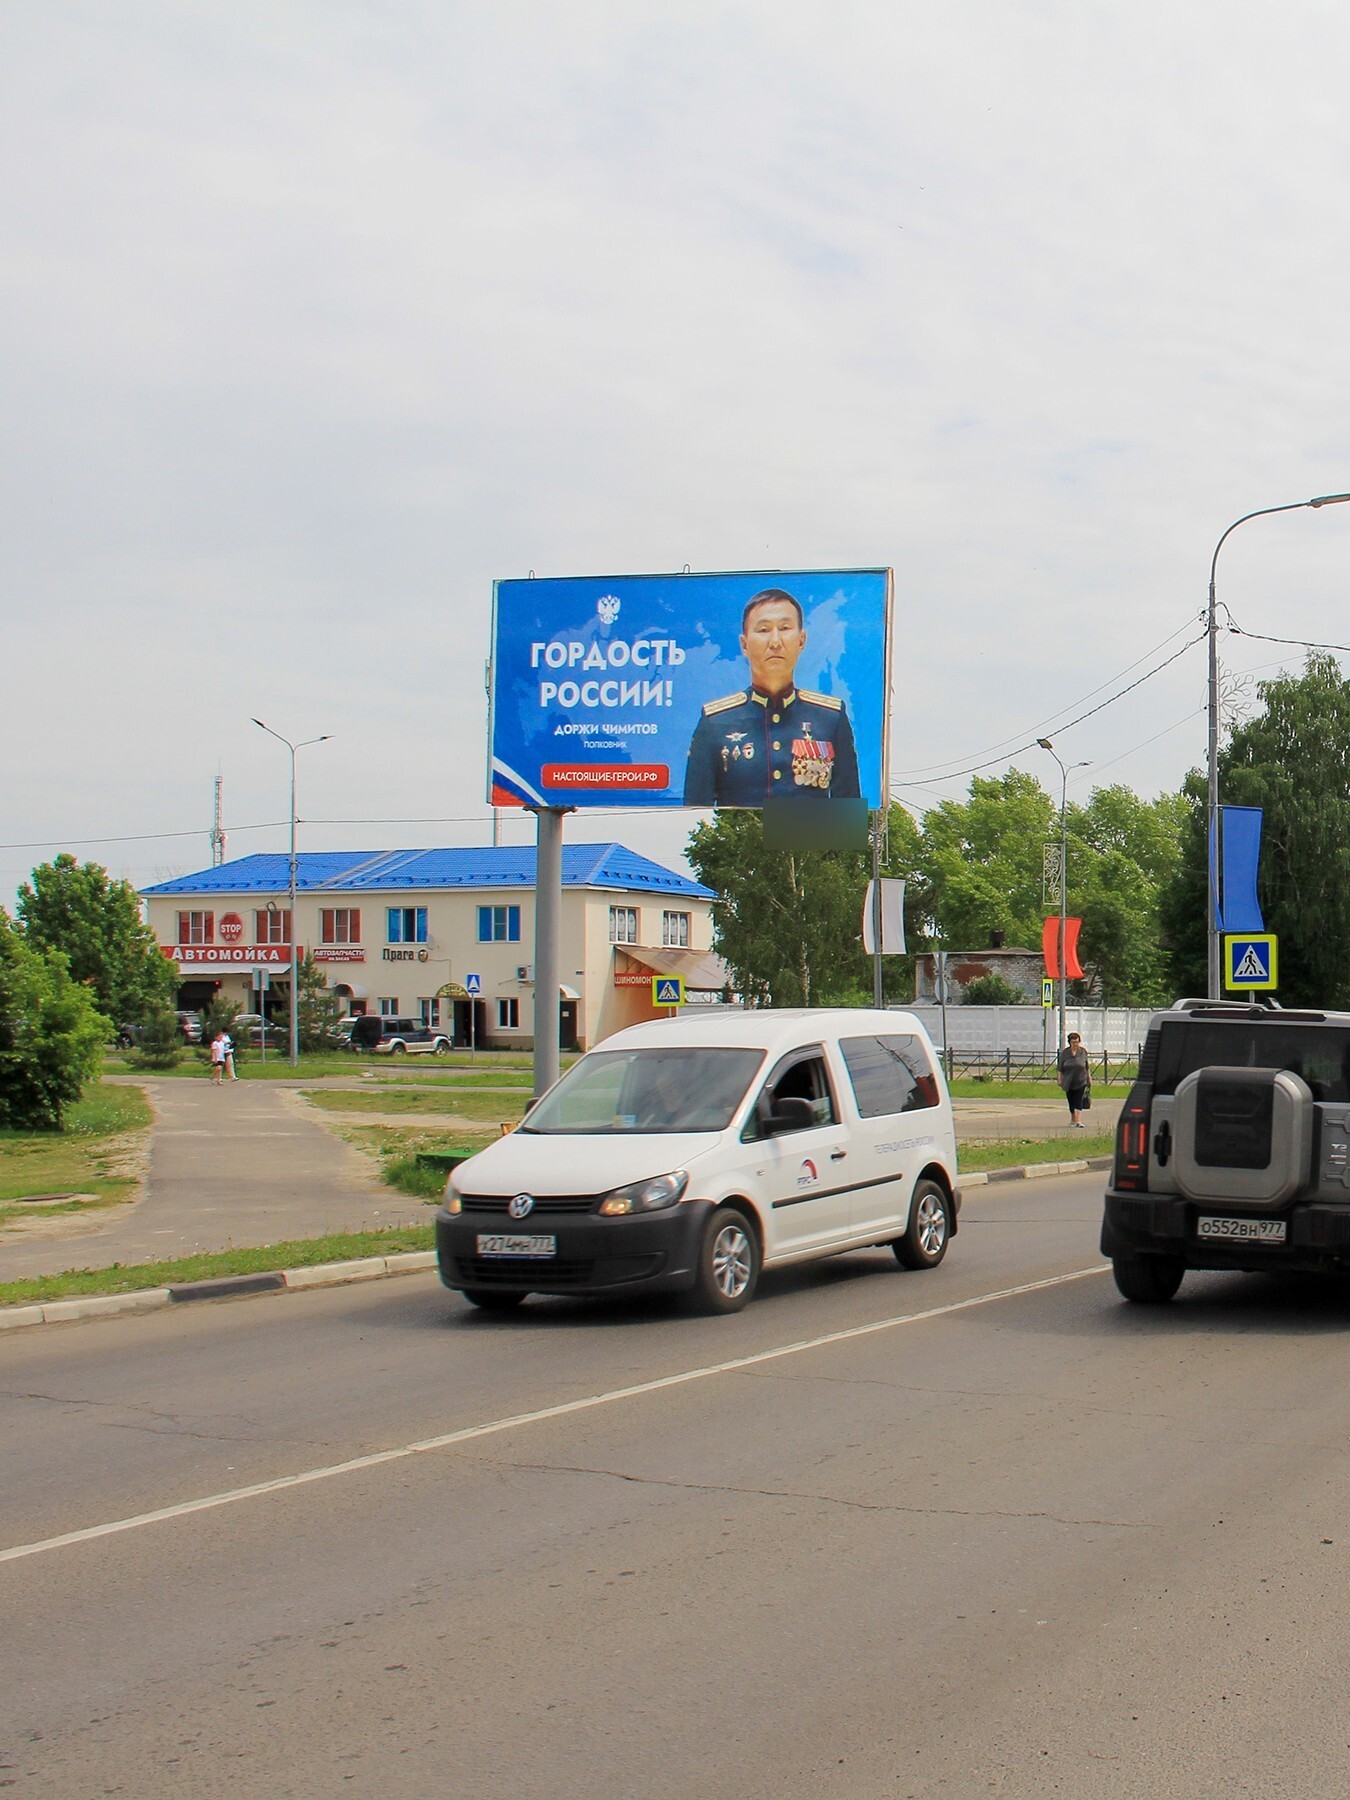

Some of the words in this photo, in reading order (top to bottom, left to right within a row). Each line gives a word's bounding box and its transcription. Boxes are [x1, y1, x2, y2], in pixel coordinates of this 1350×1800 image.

[530, 639, 687, 671] ГОРДОСТЬ
[540, 680, 674, 708] РОССИИ!
[553, 724, 599, 736] ДОРЖИ
[601, 723, 659, 735] ЧИМИТОВ
[552, 771, 658, 783] НАСТОЯЩИЕ-ГЕРОИ.РФ
[220, 924, 242, 933] STOP
[314, 949, 365, 957] АВТОЗАПЧАСТИ
[382, 948, 415, 962] Прага
[615, 976, 652, 984] ШИНОМОН
